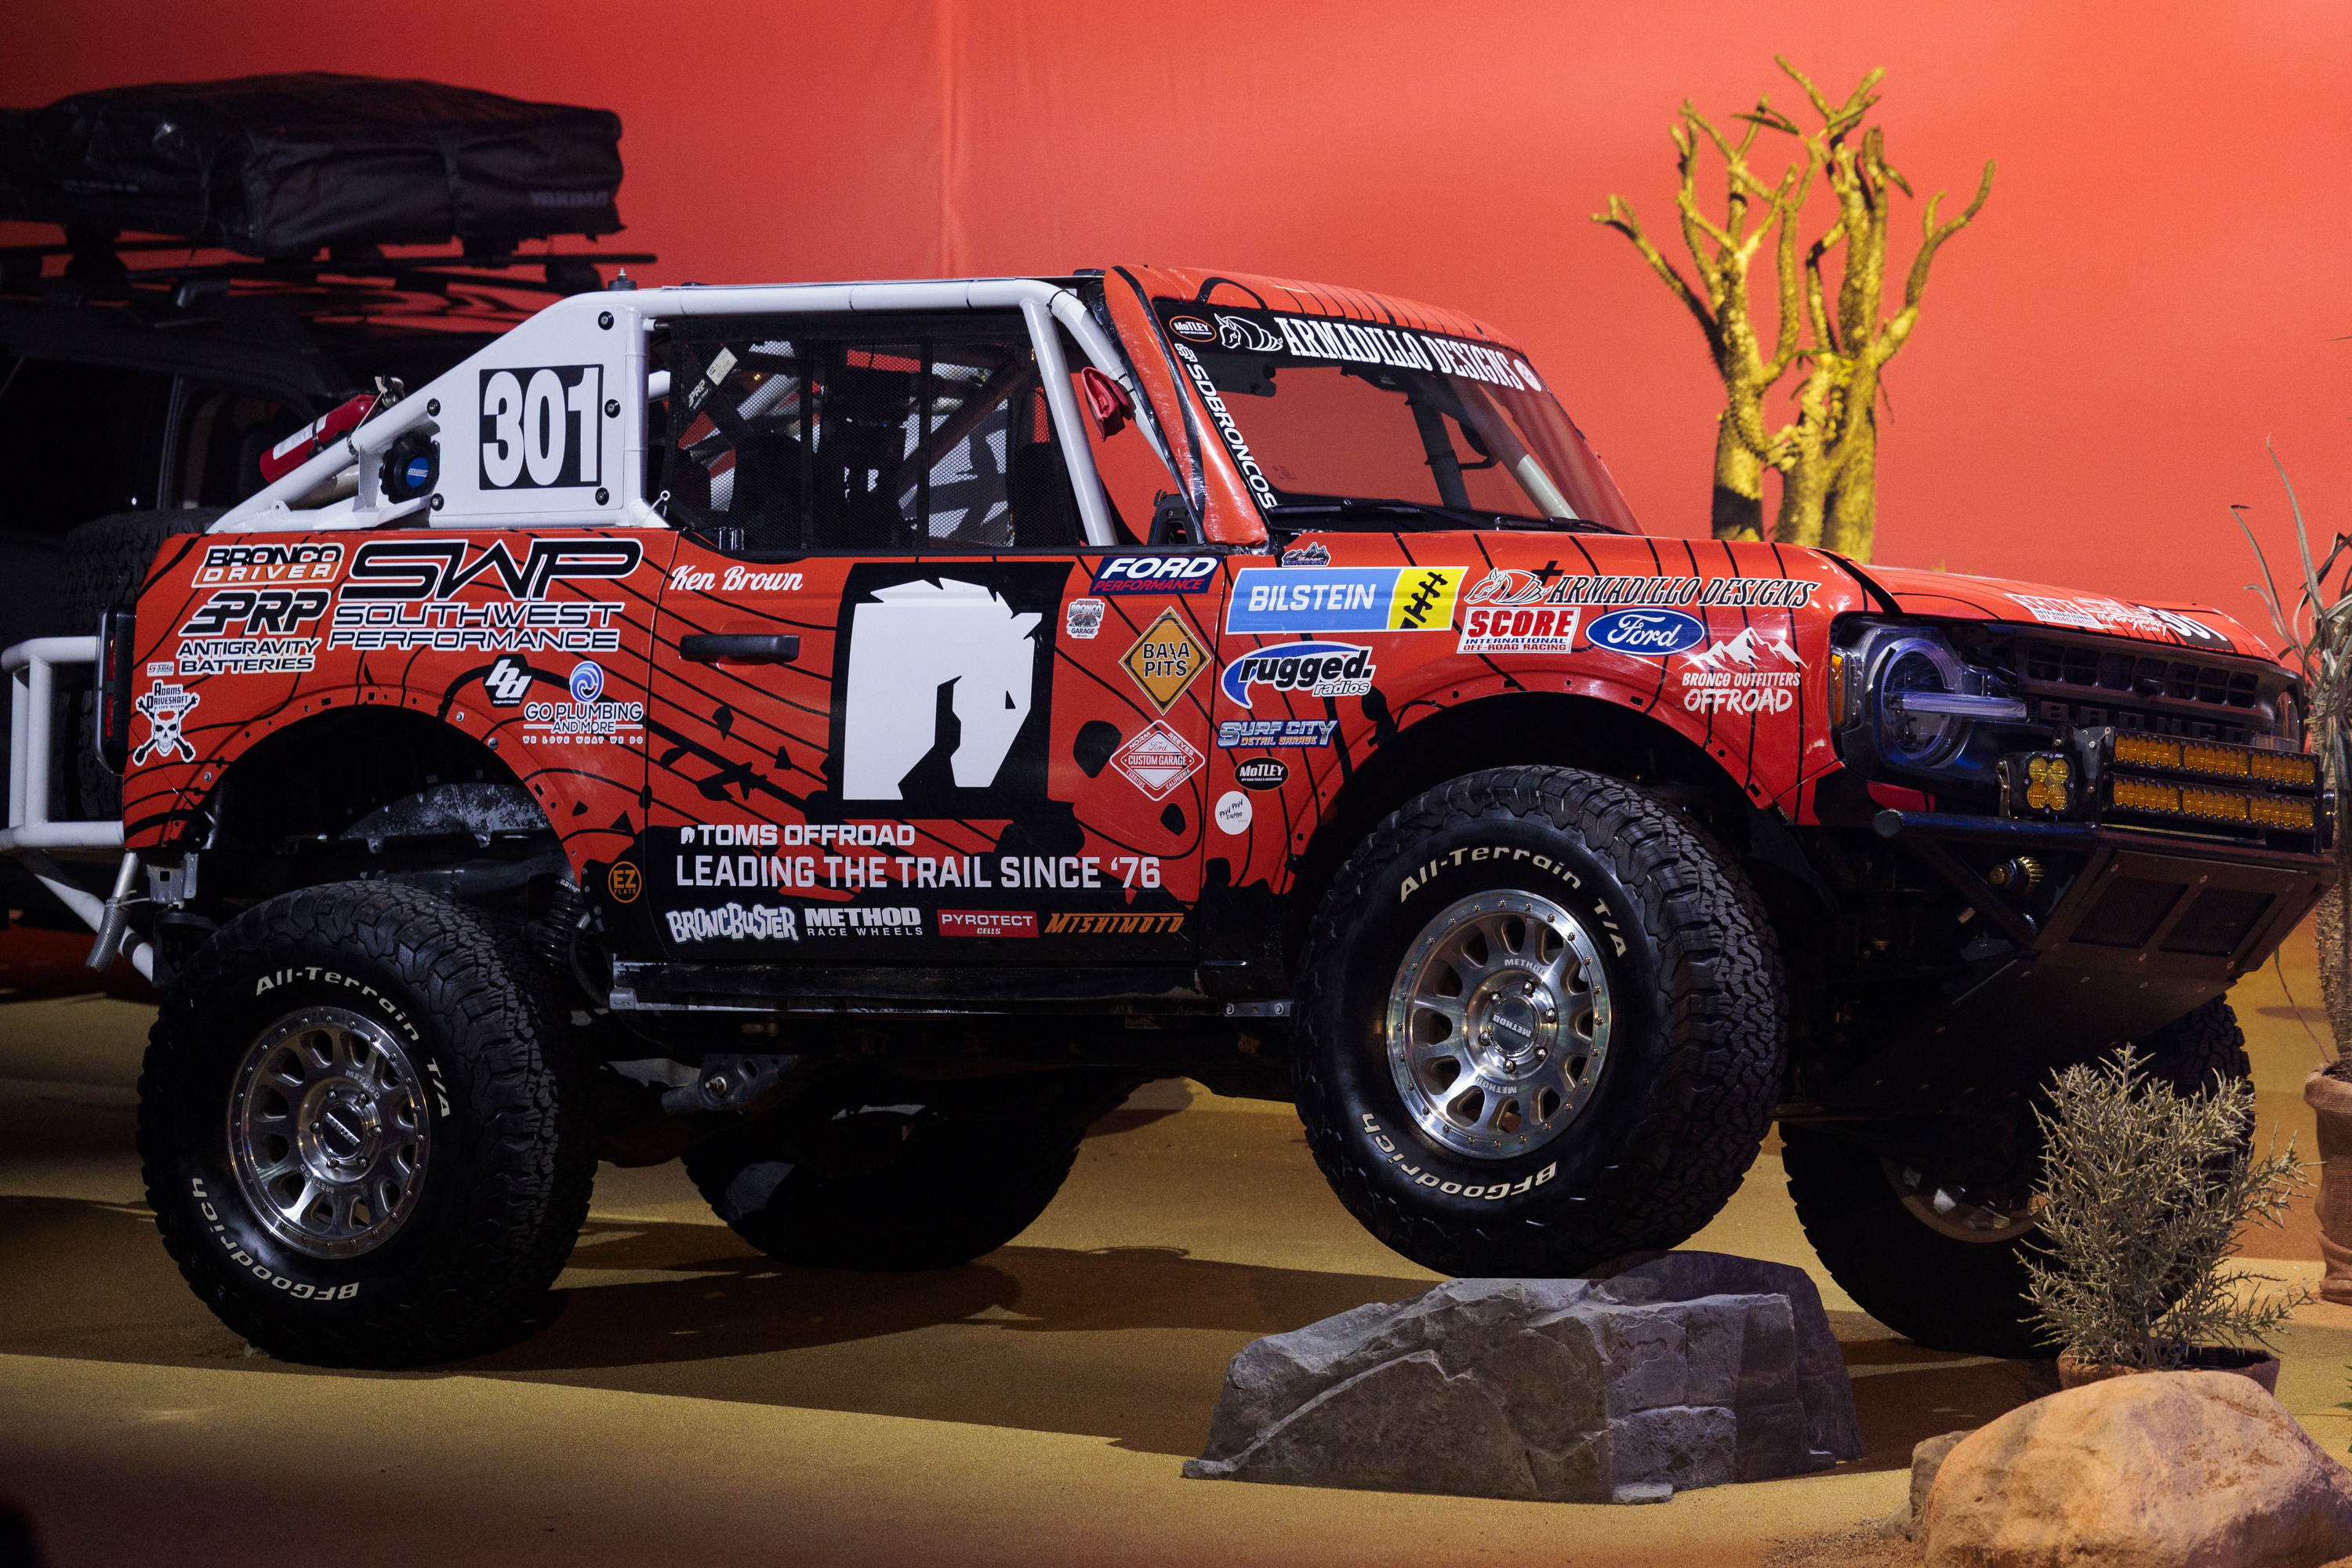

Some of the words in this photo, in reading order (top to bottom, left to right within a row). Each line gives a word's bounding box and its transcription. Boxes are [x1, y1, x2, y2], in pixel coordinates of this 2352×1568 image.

[1174, 321, 1209, 332] MoTLEY
[1274, 318, 1433, 372] ARMADILLO
[1421, 335, 1525, 392] DESIGNS
[483, 367, 599, 487] 301
[1186, 364, 1278, 509] SDBRONCOS
[204, 545, 343, 567] BRONCO
[201, 564, 332, 582] DRIVER
[339, 539, 642, 601] SWP
[669, 564, 716, 590] Ken
[721, 565, 803, 590] Brown
[1101, 557, 1218, 579] FORD
[1092, 579, 1205, 591] PERFORMANCE
[1544, 575, 1702, 605] ARMADILLO
[1697, 577, 1821, 608] DESIGNS
[1248, 583, 1377, 612] BILSTEIN
[2010, 595, 2089, 616] SCORE
[179, 591, 330, 634] PRP
[334, 603, 625, 626] SOUTHWEST
[1071, 604, 1102, 616] BRONCO
[1468, 610, 1574, 637] SCORE
[1608, 614, 1682, 647] Ford
[177, 641, 320, 656] ANTIGRAVITY
[328, 629, 619, 650] PERFORMANCE
[180, 657, 314, 673] BATTERIES
[1144, 661, 1188, 677] PITS
[1313, 681, 1370, 695] radios
[1682, 673, 1730, 687] BRONCO
[1733, 672, 1801, 687] OUTFITTERS
[525, 704, 552, 720] GO
[555, 703, 643, 720] PLUMBING
[1684, 688, 1793, 715] OFFROAD
[554, 721, 578, 732] AND
[581, 721, 615, 732] MORE
[1218, 720, 1284, 746] SURF
[1285, 720, 1338, 746] CITY
[1129, 731, 1151, 750] NORM
[1167, 731, 1195, 757] REEVES
[1148, 741, 1168, 752] Ford
[1240, 737, 1276, 746] DETAIL
[1278, 735, 1318, 746] GARAGE
[1128, 755, 1158, 766] CUSTOM
[1159, 755, 1187, 766] GARAGE
[1240, 764, 1284, 777] MoTLEY
[1126, 769, 1145, 789] CERRITOS
[1165, 768, 1191, 790] CALIFORNIA
[698, 825, 778, 845] TOMS
[784, 825, 915, 846] OFFROAD
[614, 870, 636, 889] EZ
[677, 855, 815, 887] LEADING
[823, 857, 887, 887] THE
[895, 856, 992, 887] TRAIL
[1000, 856, 1102, 887] SINCE
[1400, 845, 1582, 903] All-Terrain
[1593, 897, 1628, 958] T/A
[804, 907, 922, 927] METHOD
[942, 913, 1033, 927] PYROTECT
[1044, 913, 1185, 933] MISHIMOTO
[807, 927, 848, 936] RACE
[856, 927, 923, 935] WHEELS
[1504, 958, 1546, 975] METHOD
[1493, 1014, 1532, 1037] METHOD
[255, 966, 420, 1041] All-Terrain
[426, 1057, 452, 1117] T/A
[1475, 1074, 1517, 1094] METHOD
[1361, 1112, 1558, 1201] BFGoodrich
[191, 1177, 360, 1301] BFGoodrich
